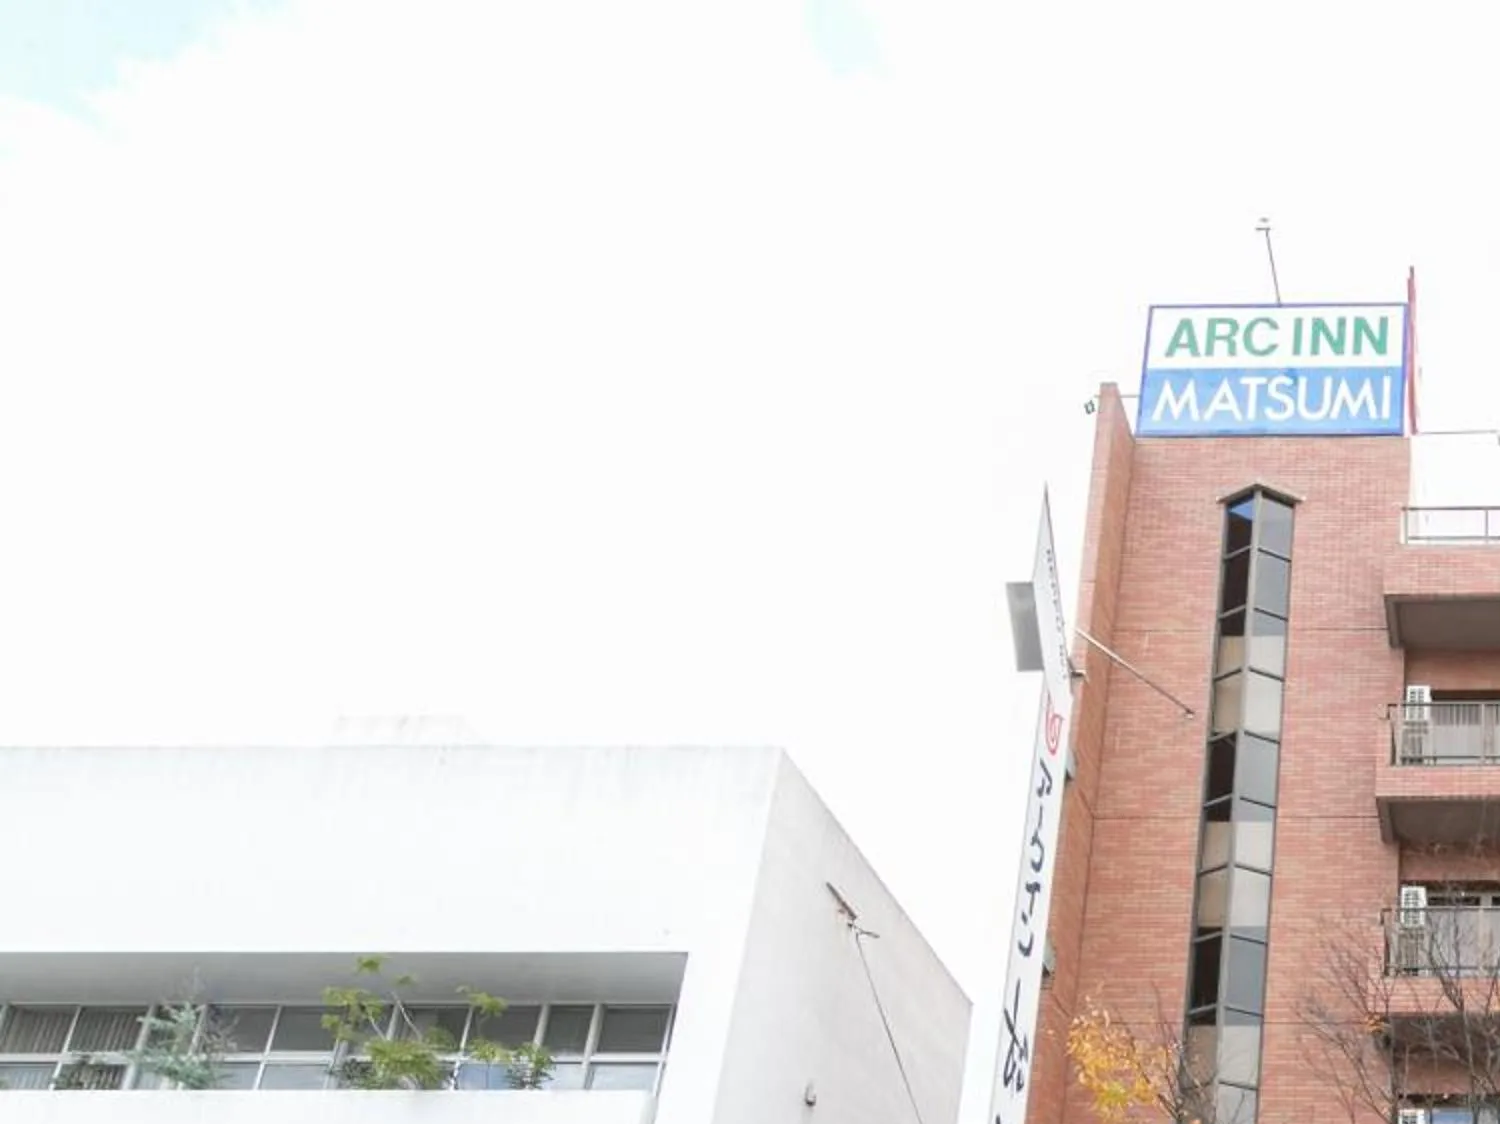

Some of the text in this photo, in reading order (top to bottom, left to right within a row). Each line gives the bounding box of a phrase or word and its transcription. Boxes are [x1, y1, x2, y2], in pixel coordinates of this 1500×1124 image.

[1164, 316, 1389, 357] ARC INN
[1151, 375, 1392, 422] MATSUMI
